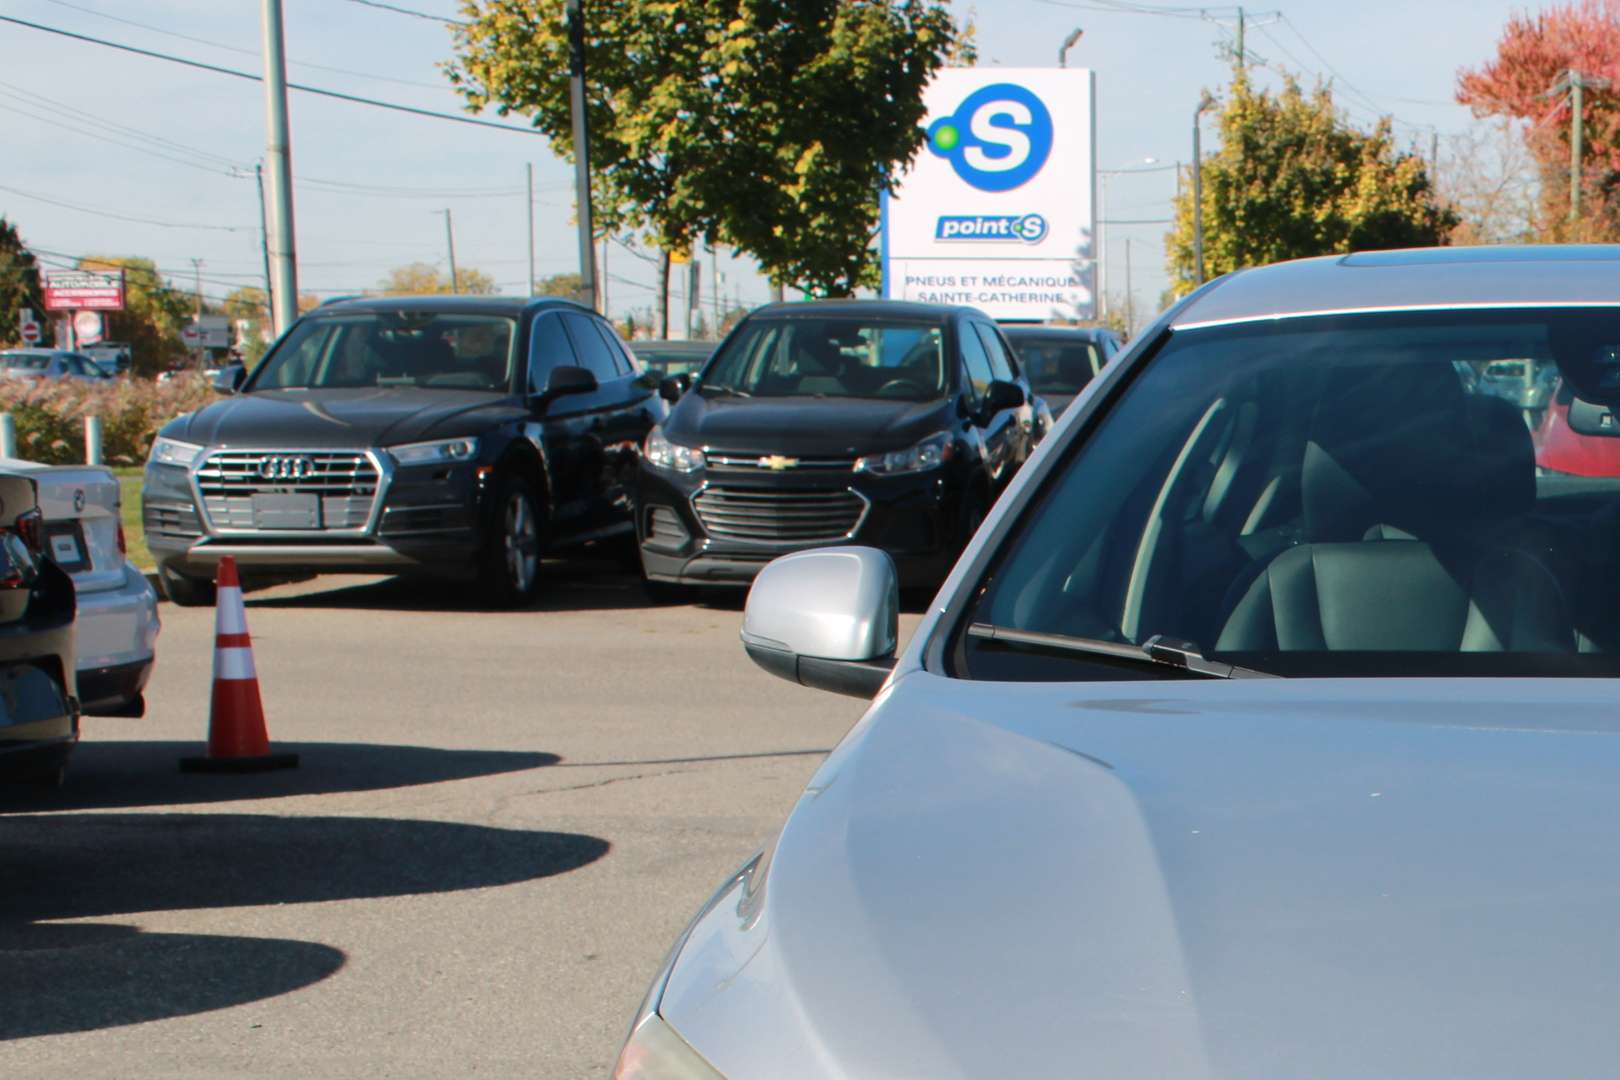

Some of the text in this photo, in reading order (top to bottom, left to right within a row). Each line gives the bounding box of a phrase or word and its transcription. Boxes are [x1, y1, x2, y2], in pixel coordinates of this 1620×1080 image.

[963, 99, 1033, 173] S
[942, 216, 1042, 238] point S
[905, 273, 1077, 288] PNEUS ET MÉCANIQUE
[917, 291, 1065, 304] SAINTE-CATHERINE
